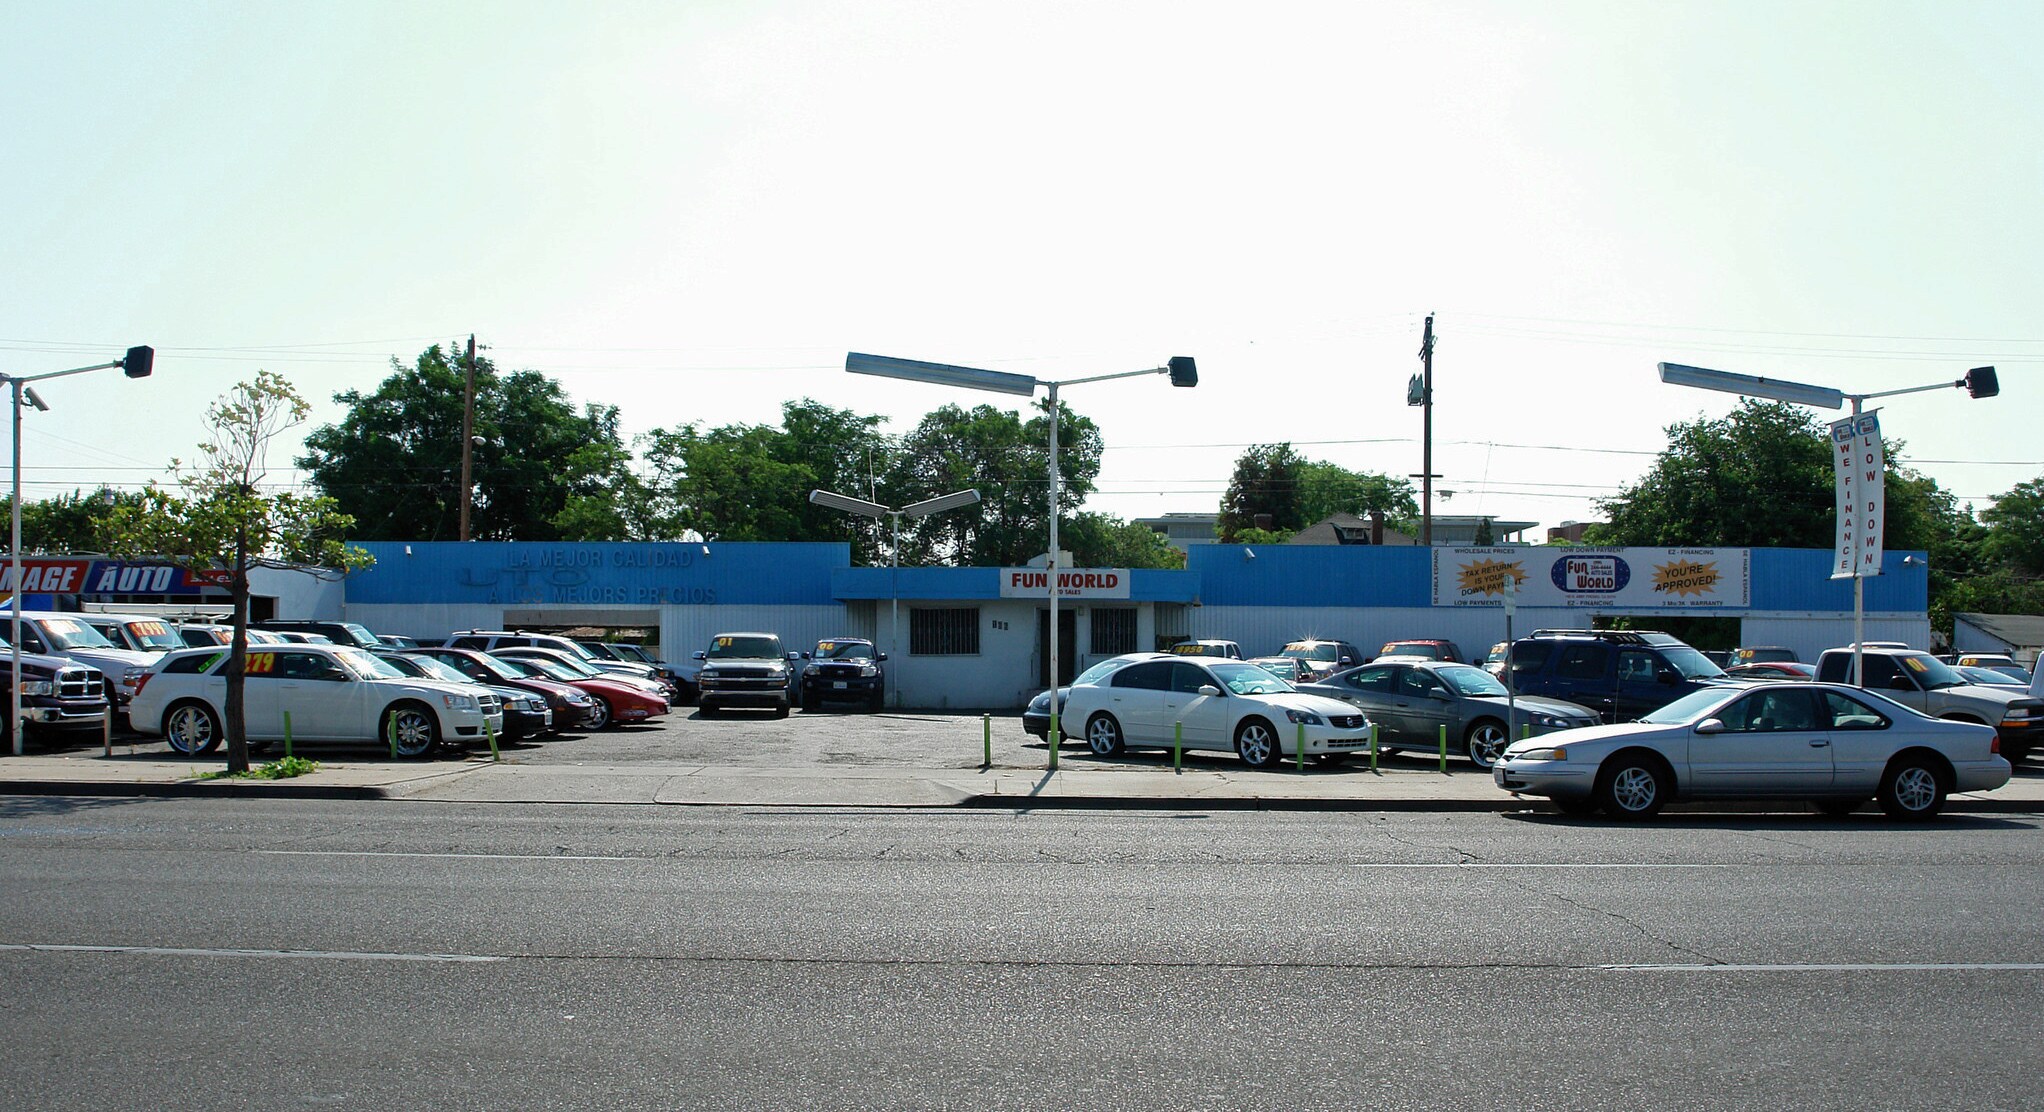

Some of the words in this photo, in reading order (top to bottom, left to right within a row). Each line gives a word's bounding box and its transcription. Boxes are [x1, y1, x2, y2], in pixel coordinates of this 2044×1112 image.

[1840, 444, 1850, 466] WE
[1865, 437, 1876, 482] LOW
[1841, 477, 1852, 568] FINANCE
[1865, 502, 1876, 564] DOWN
[510, 550, 530, 566] LA
[540, 550, 602, 567] MEJOR
[613, 550, 692, 568] CALIDAD
[1482, 563, 1512, 574] RETURN
[1665, 565, 1703, 578] YOU'RE
[97, 566, 174, 592] AUTO
[1012, 573, 1047, 587] FUN
[1057, 573, 1118, 588] WORLD
[1655, 575, 1716, 592] APPROVED!
[553, 587, 627, 603] MEJORS
[1462, 586, 1485, 596] DOWN
[719, 637, 732, 646] 01
